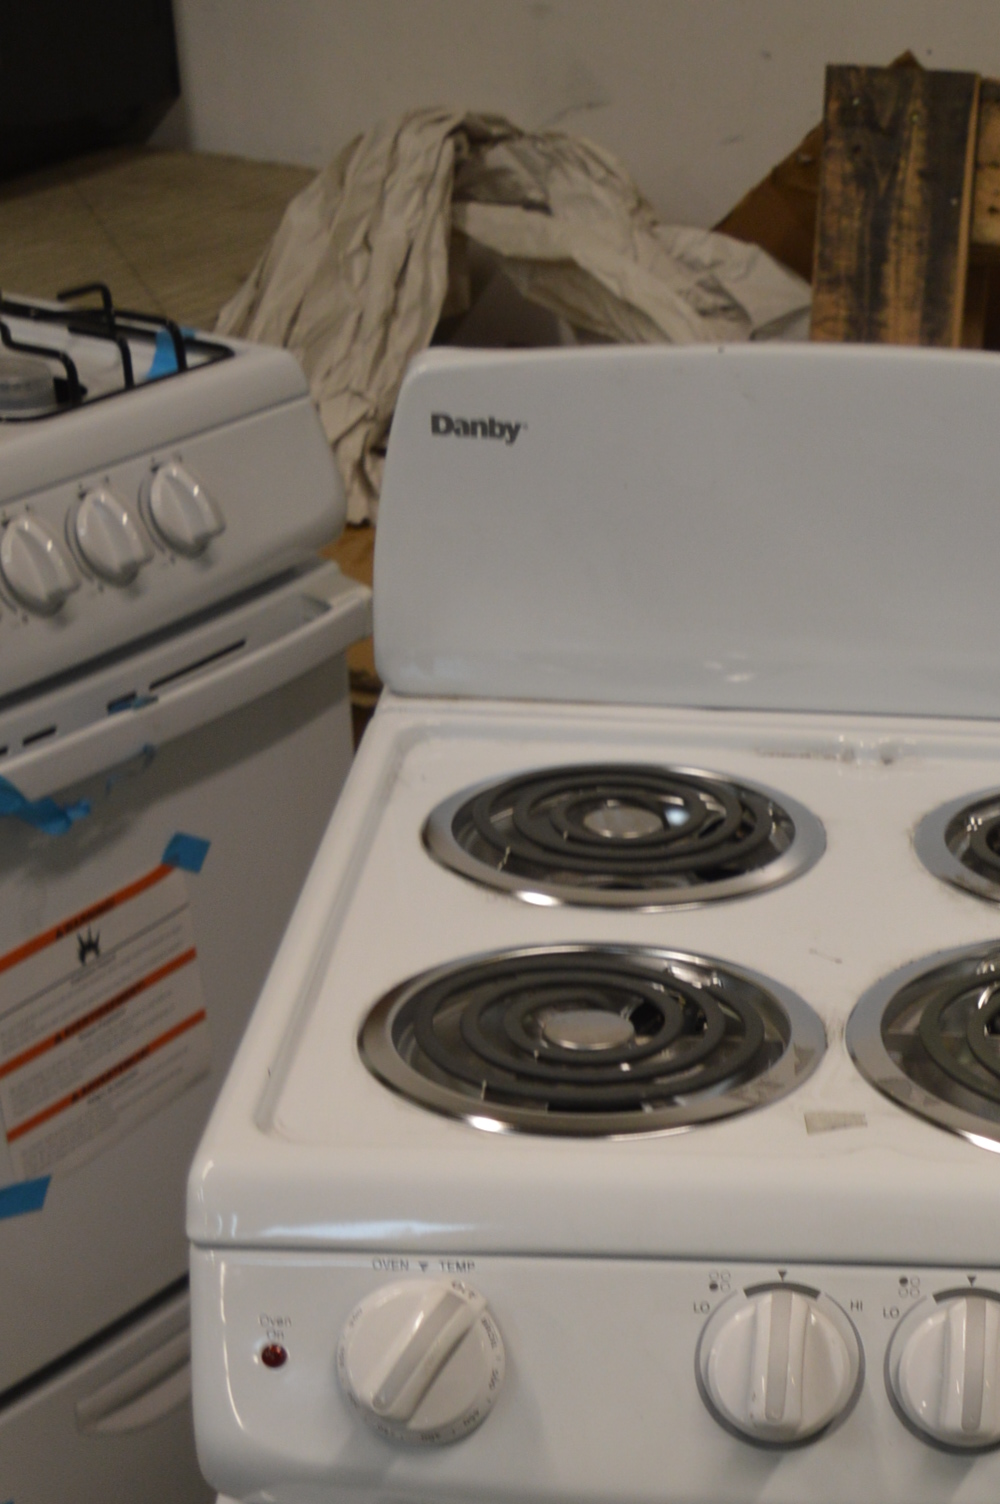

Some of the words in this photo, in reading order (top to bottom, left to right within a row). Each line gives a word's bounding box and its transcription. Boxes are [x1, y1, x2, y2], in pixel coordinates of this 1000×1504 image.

[430, 412, 522, 446] Danby
[372, 1258, 409, 1272] OVEN
[439, 1260, 476, 1273] TEMP
[693, 1302, 710, 1314] LO
[850, 1300, 863, 1312] HI
[882, 1307, 899, 1319] LO
[259, 1312, 292, 1328] Oven
